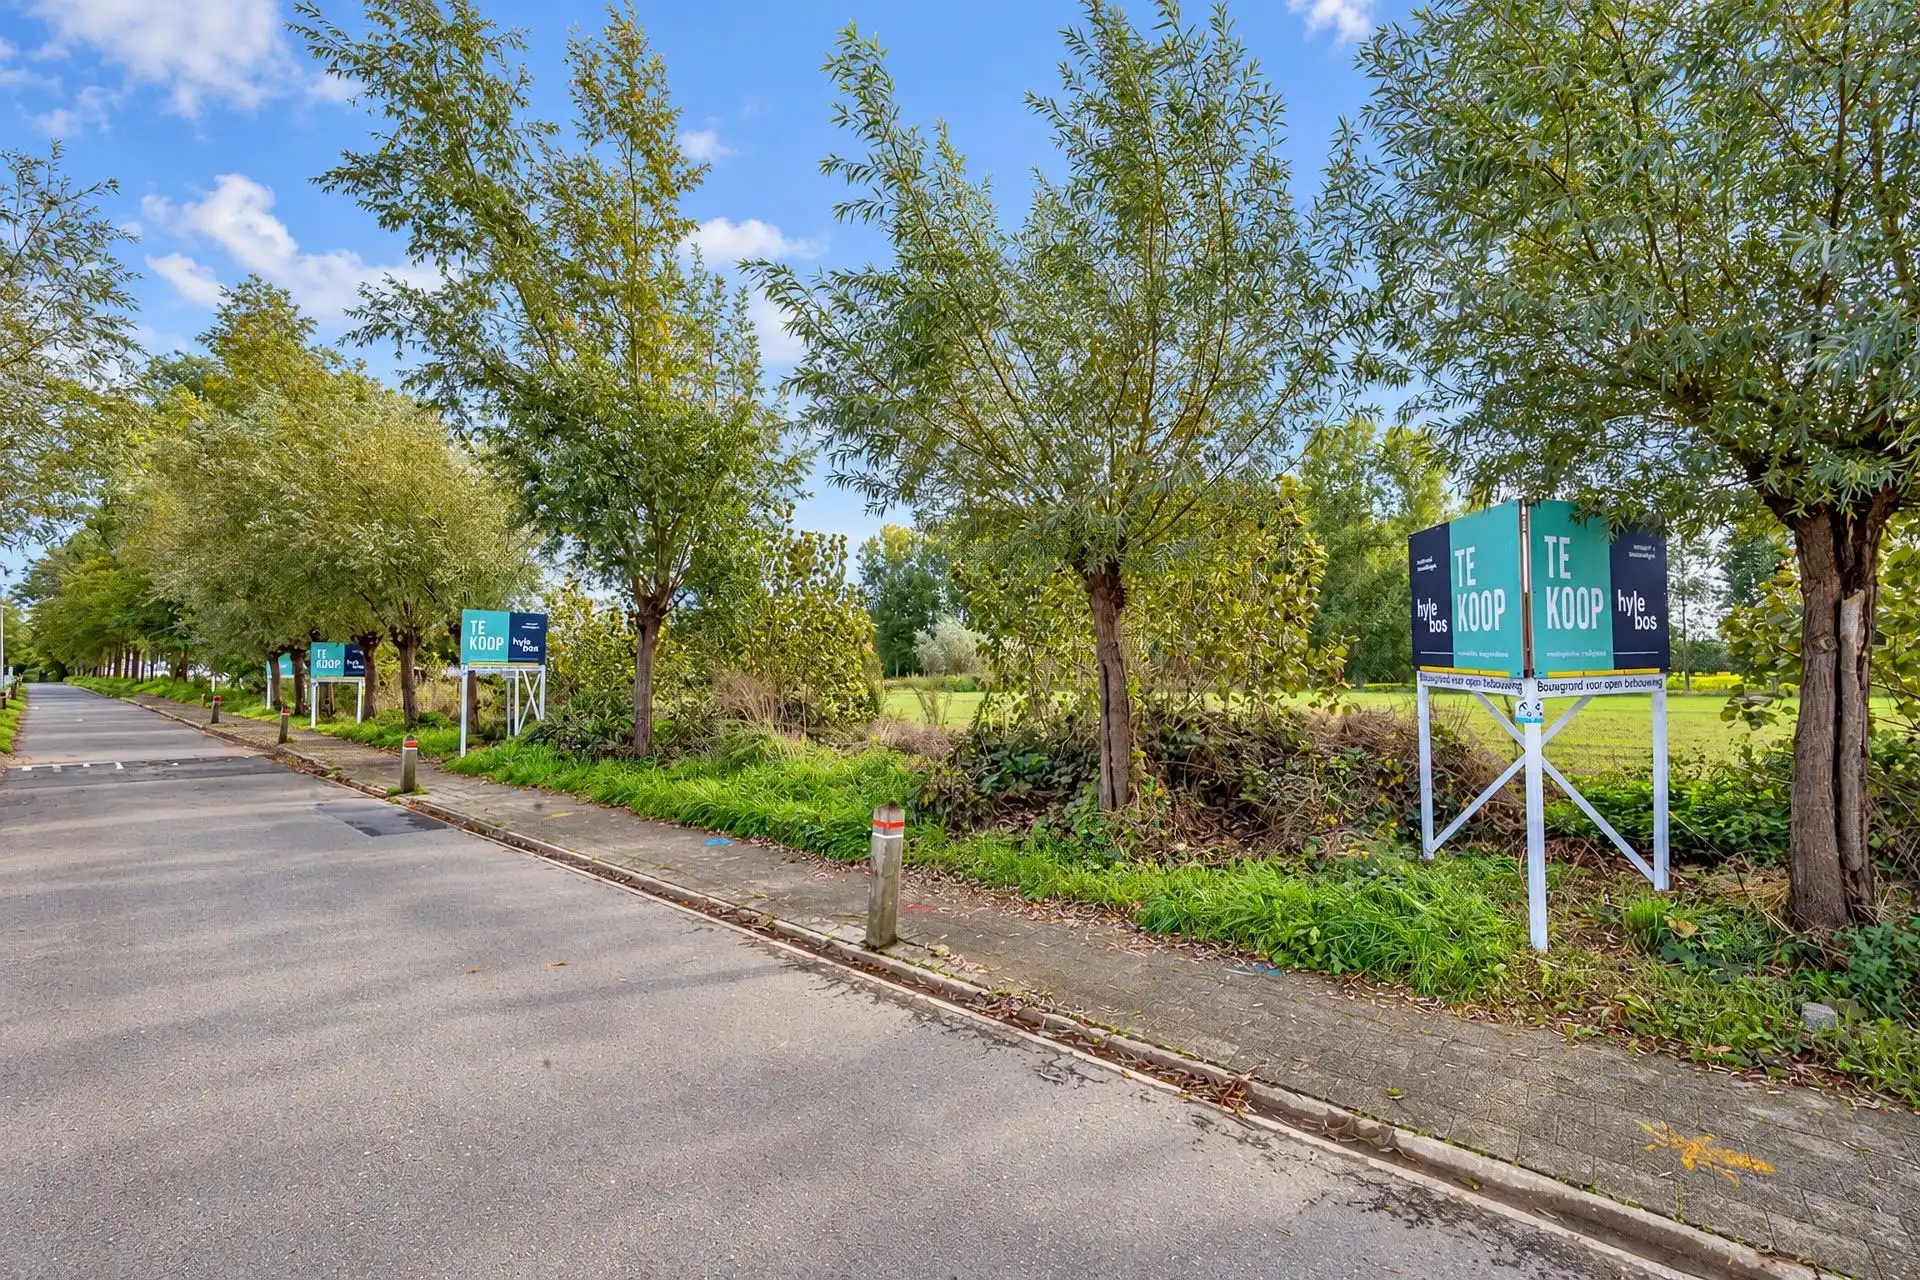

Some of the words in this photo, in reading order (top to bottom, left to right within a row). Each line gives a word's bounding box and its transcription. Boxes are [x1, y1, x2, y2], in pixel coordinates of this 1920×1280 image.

[1454, 546, 1476, 587] TE
[1544, 535, 1571, 579] TE
[1417, 598, 1438, 621] hyle
[1457, 589, 1506, 632] KOOP
[1546, 586, 1604, 630] KOOP
[1617, 589, 1646, 616] hyle
[470, 620, 486, 635] TE
[469, 636, 504, 651] KOOP
[1537, 680, 1583, 694] Bouwgrond
[1586, 681, 1602, 690] voor
[1604, 680, 1623, 690] open
